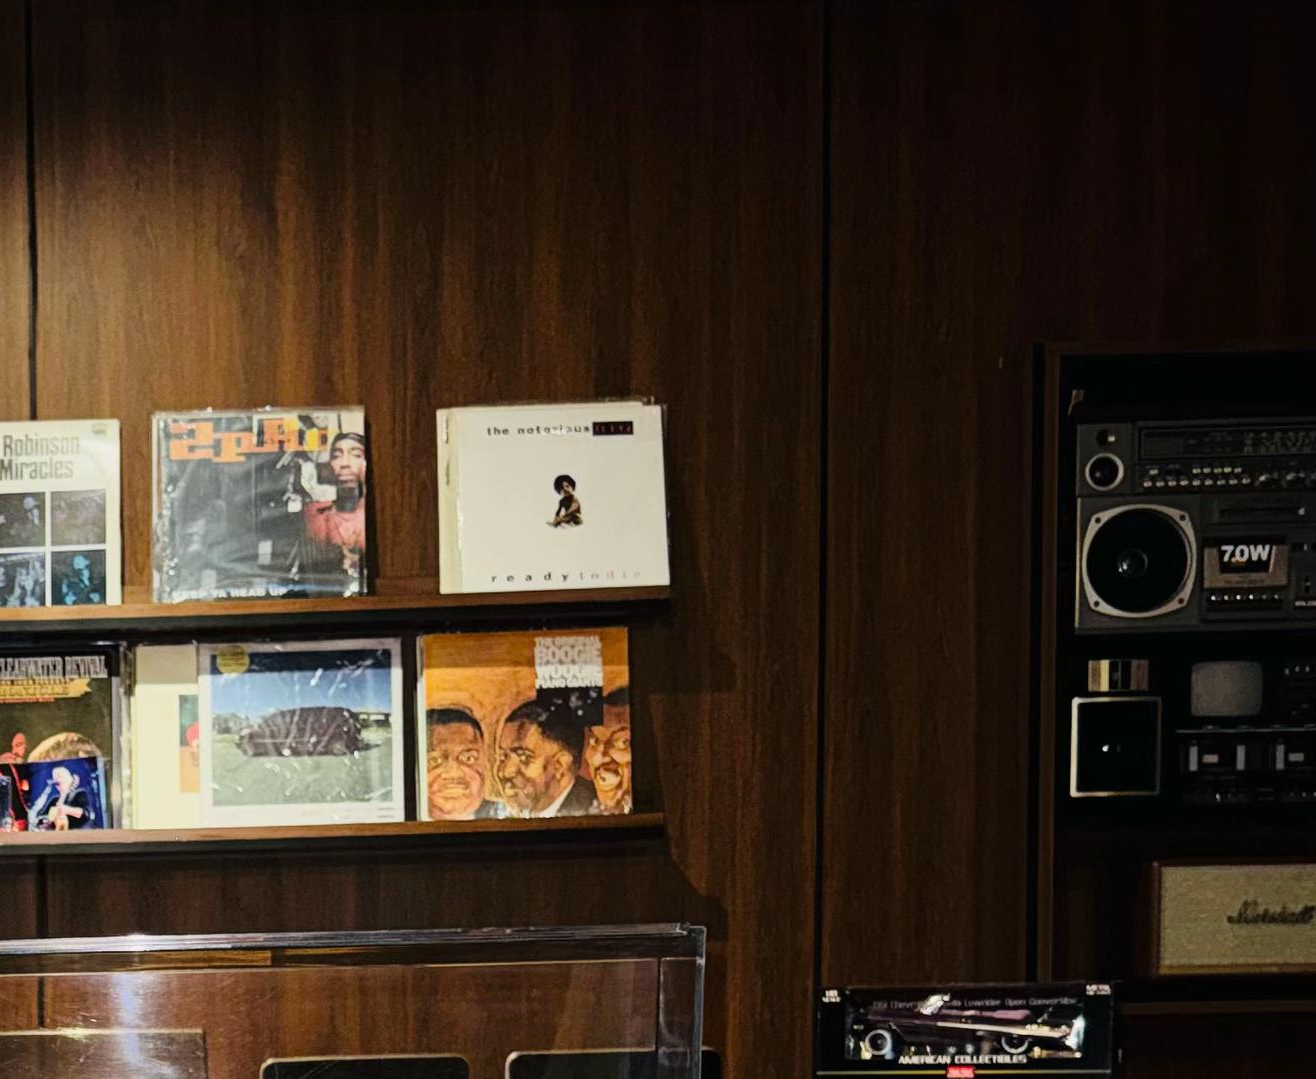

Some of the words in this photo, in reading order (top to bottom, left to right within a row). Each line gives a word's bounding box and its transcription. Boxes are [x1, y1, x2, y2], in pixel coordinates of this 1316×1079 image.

[487, 426, 509, 436] the
[3, 434, 80, 457] Robinson
[0, 458, 74, 481] Miracles
